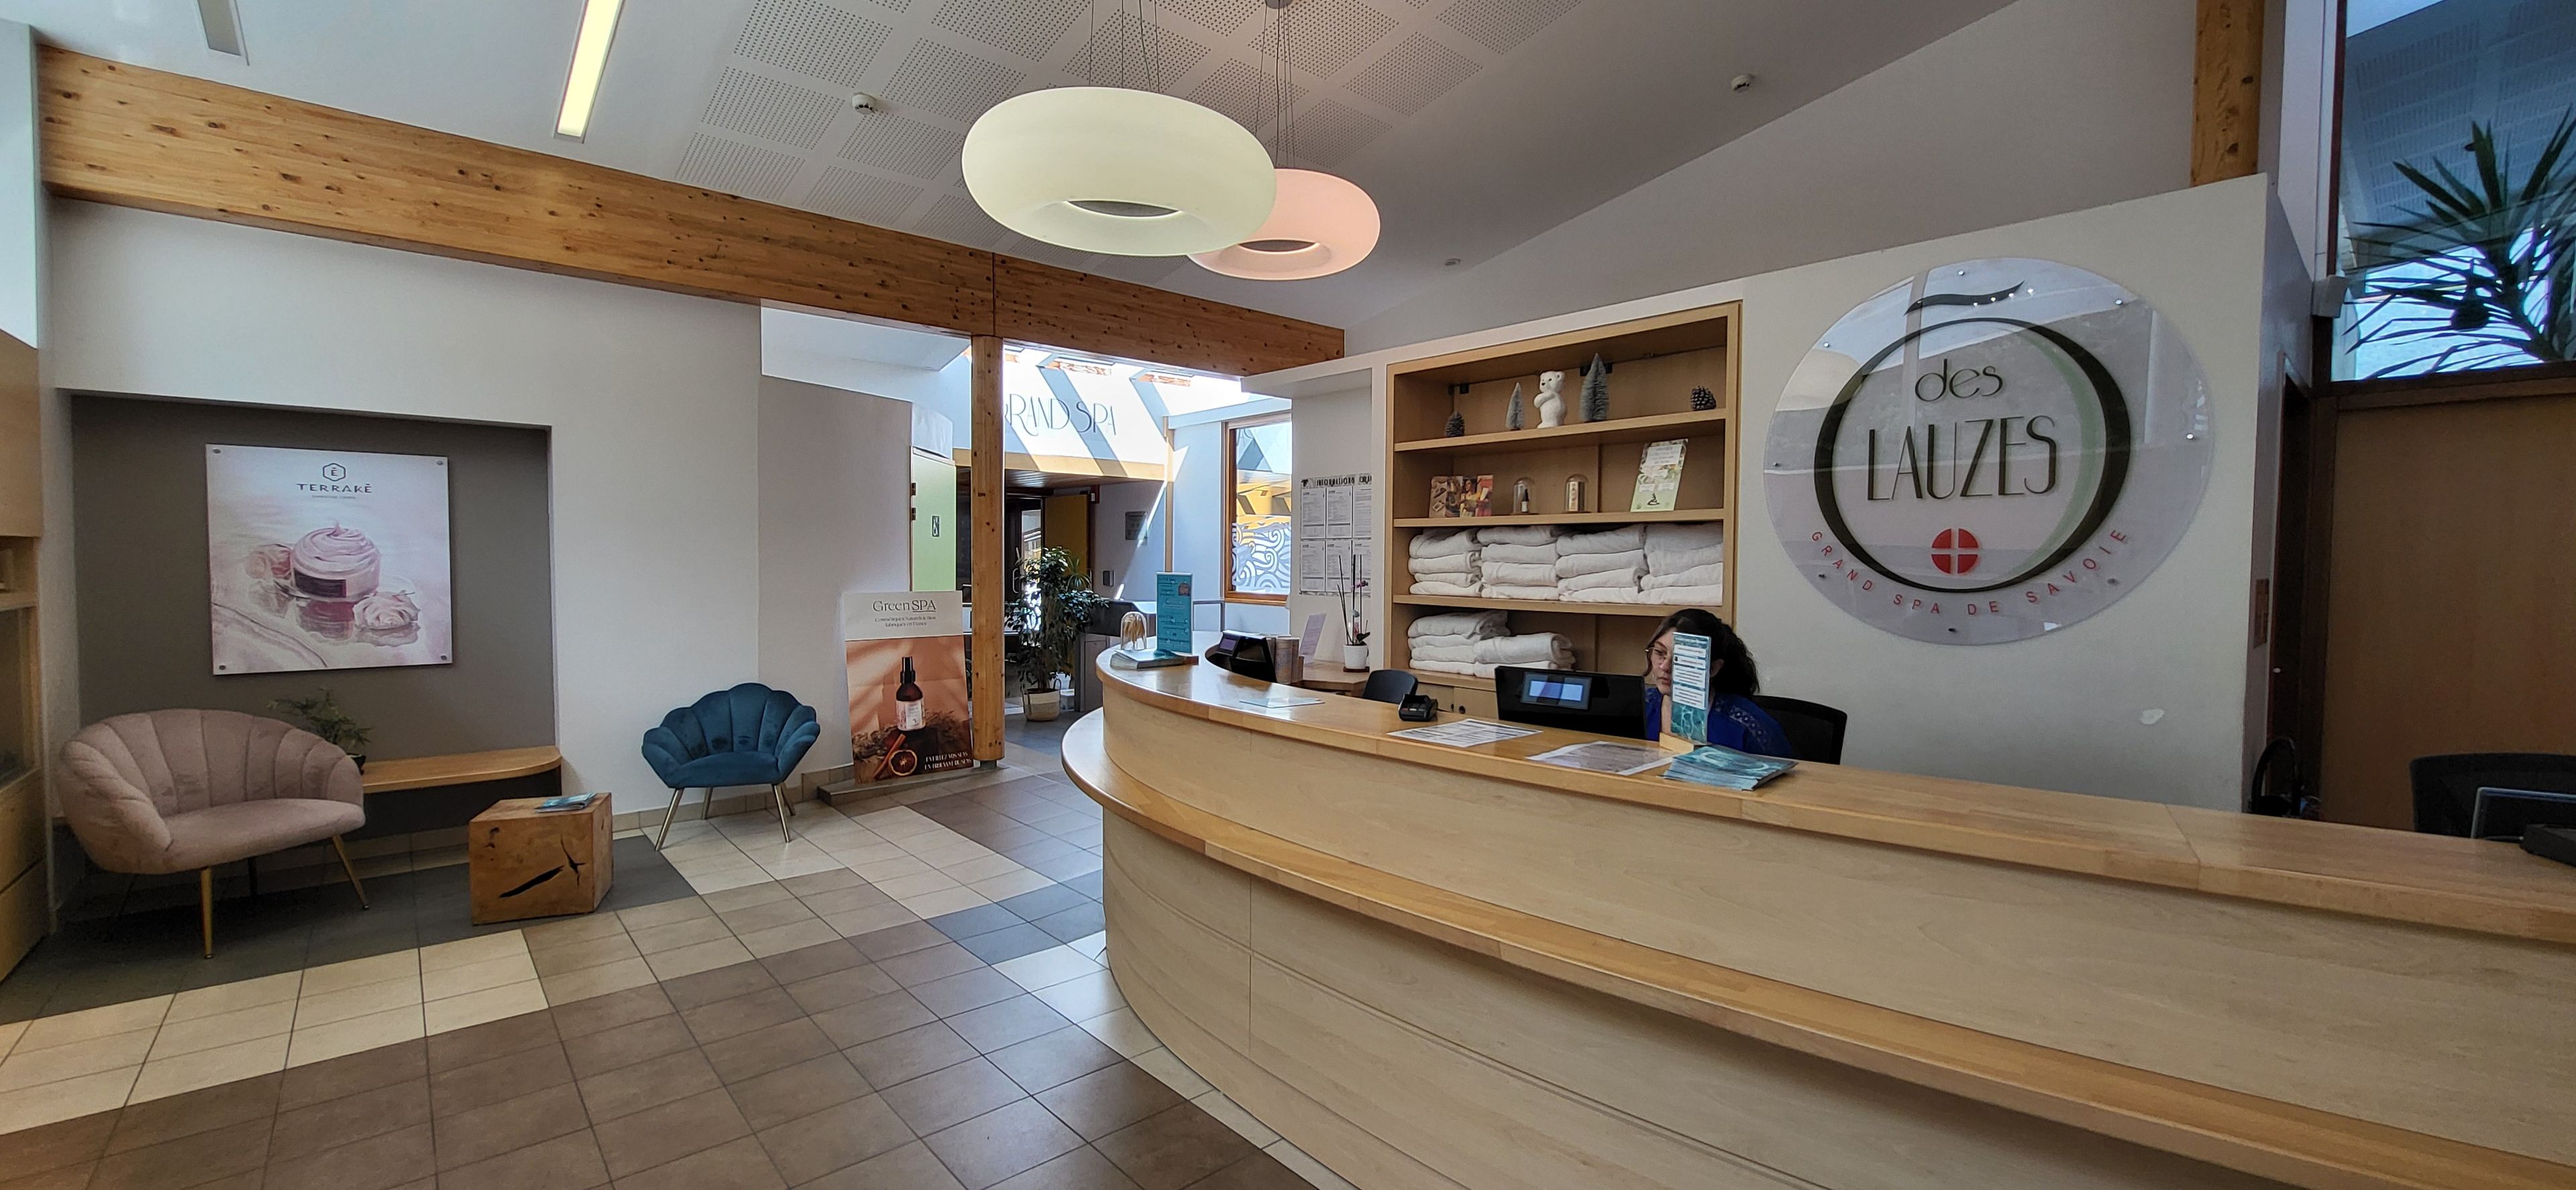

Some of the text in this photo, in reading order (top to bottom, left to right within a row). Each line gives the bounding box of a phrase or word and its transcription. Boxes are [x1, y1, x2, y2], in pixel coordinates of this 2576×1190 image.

[1915, 358, 2003, 402] des
[1004, 393, 1116, 437] RAND SPA
[1867, 415, 2057, 500] LAUZES
[1811, 529, 2127, 615] GRAND SPA DE SAVOIE
